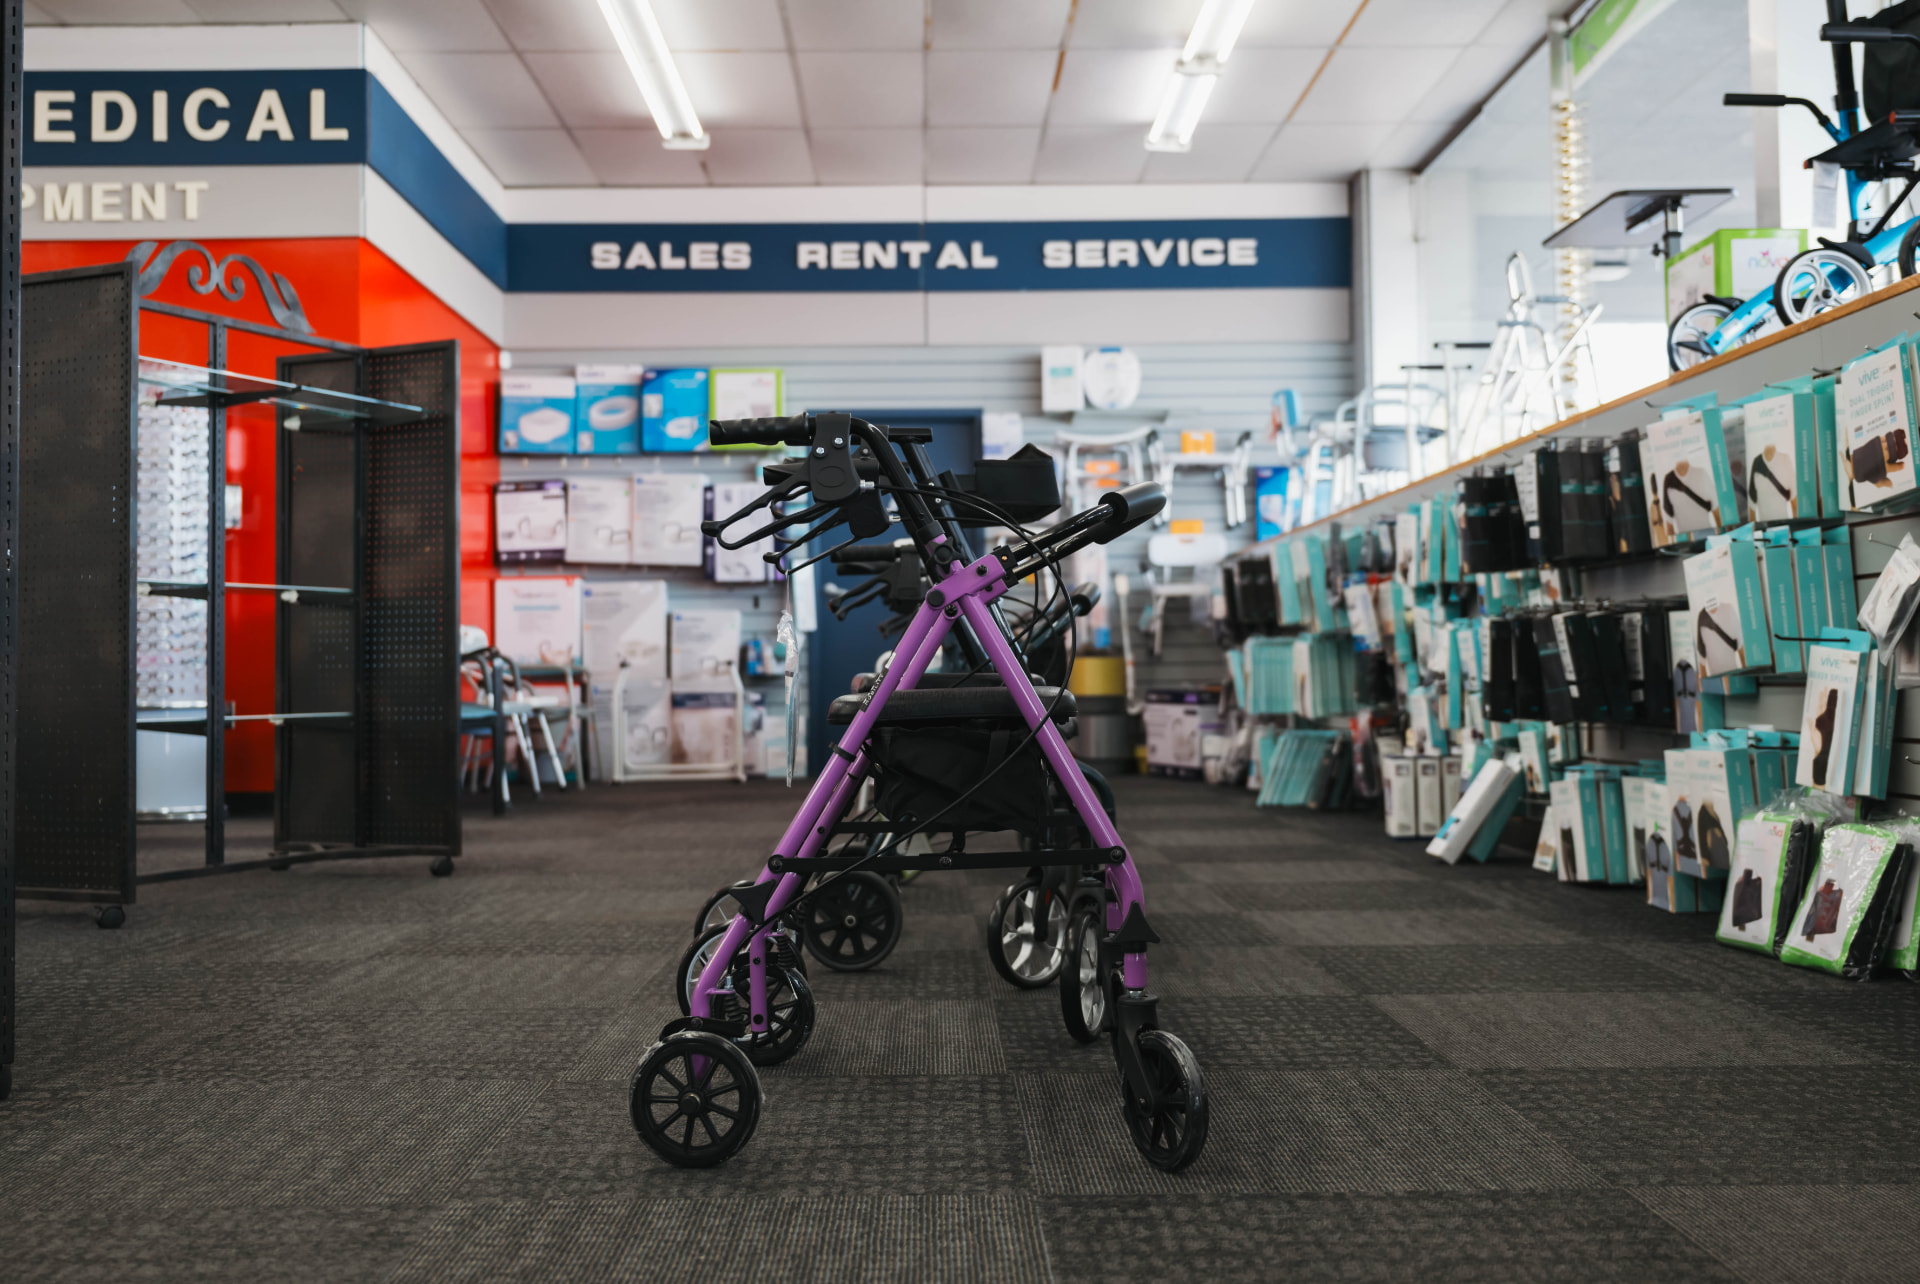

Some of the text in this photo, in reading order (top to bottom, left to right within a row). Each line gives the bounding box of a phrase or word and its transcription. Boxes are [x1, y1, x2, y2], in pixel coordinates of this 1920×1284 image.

[33, 88, 349, 143] EDICAL
[591, 237, 1259, 270] SALES RENTAL SERVICE
